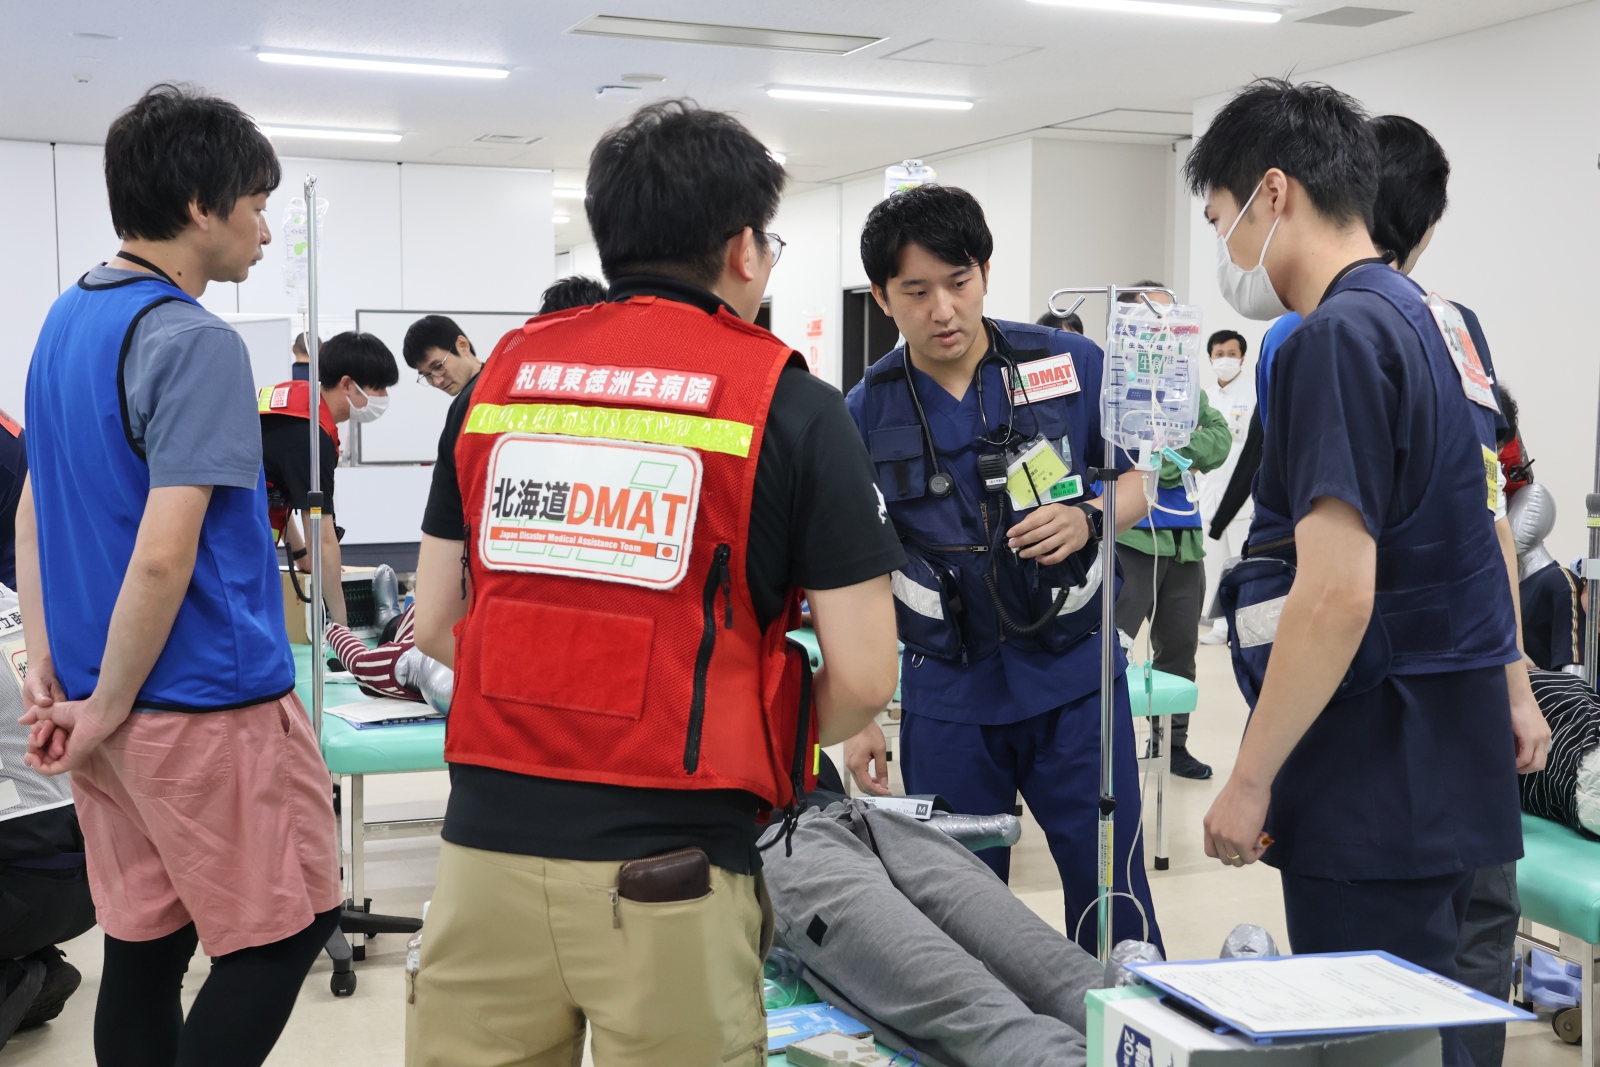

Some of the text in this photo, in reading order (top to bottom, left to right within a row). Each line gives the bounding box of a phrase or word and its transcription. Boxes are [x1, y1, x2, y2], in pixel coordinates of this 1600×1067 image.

[515, 364, 712, 404] 札幌東徳洲会病院
[491, 477, 688, 537] 北海道DMAT
[498, 529, 642, 553] Japan Disaster Medical Assistance Team
[918, 806, 926, 814] M
